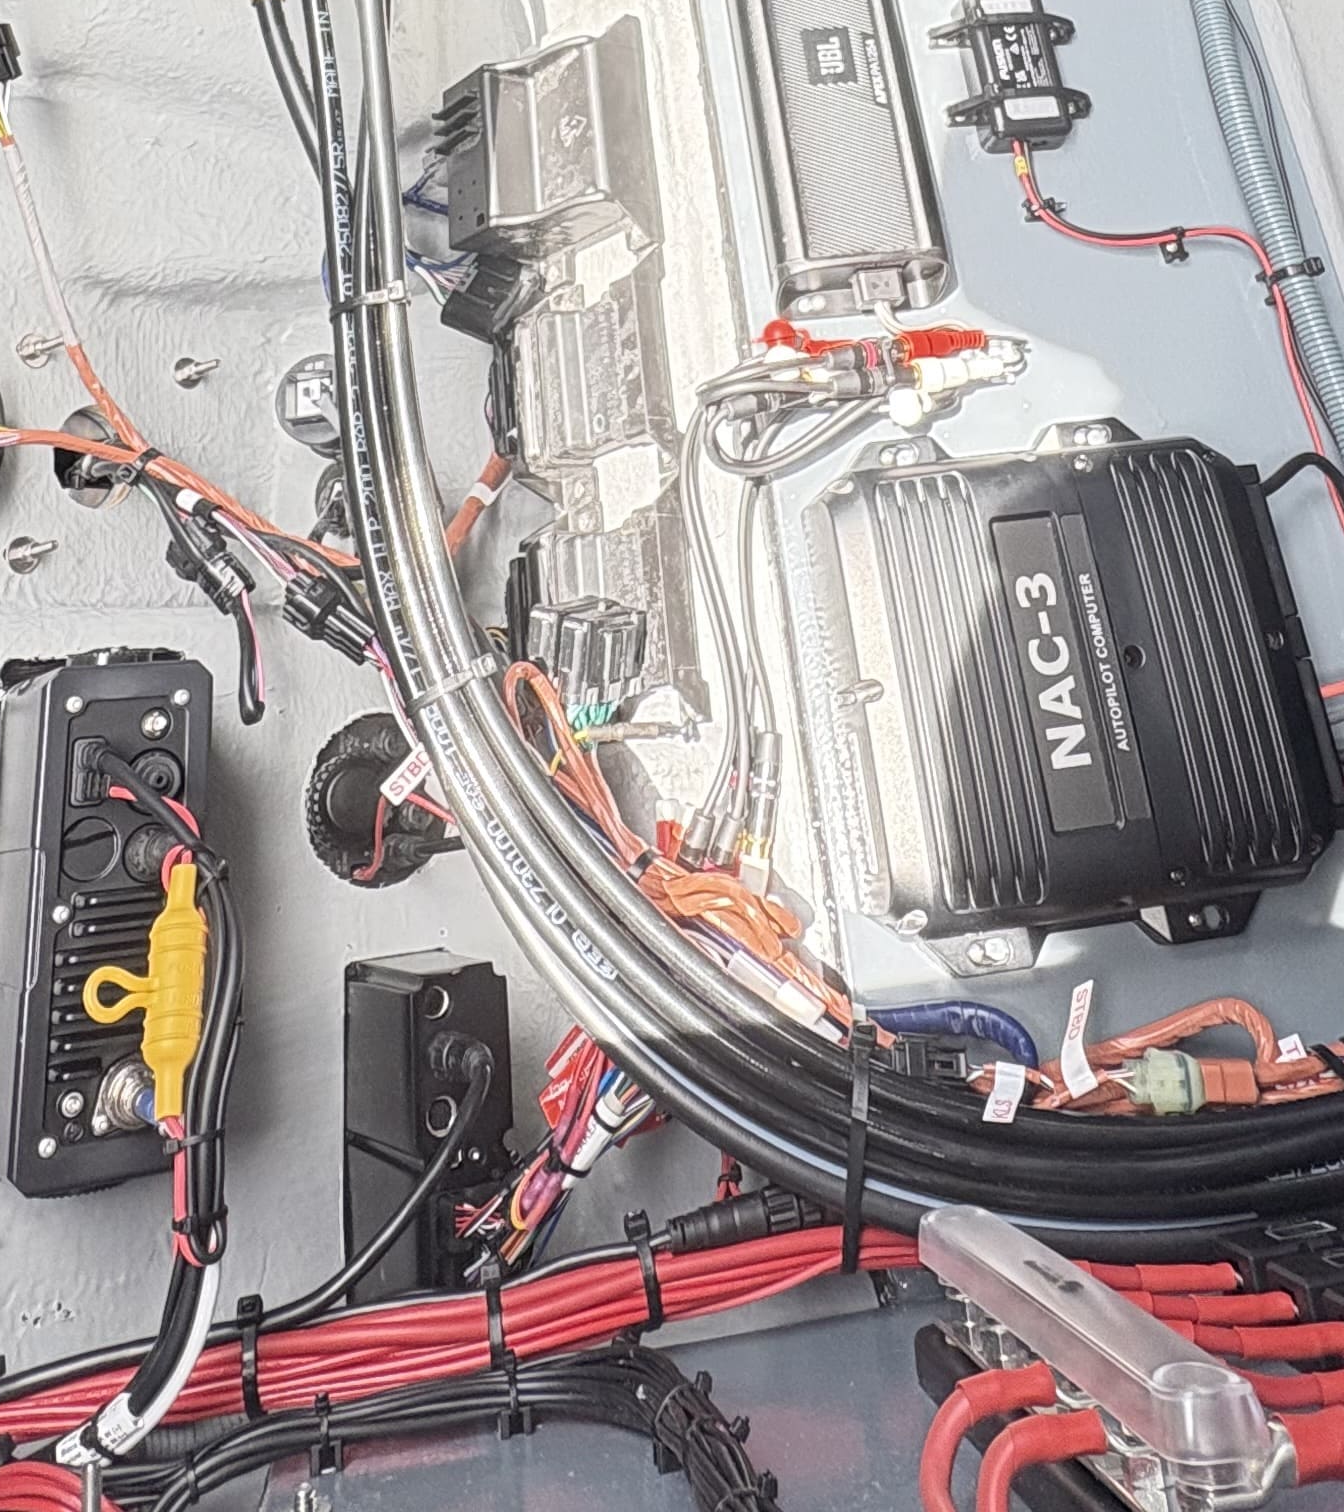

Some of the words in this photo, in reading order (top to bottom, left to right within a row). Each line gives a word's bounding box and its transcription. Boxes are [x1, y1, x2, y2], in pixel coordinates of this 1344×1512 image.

[323, 44, 339, 98] MADE
[817, 35, 846, 77] JBL
[1078, 573, 1109, 658] COMPUTER
[1015, 572, 1093, 770] NAC-3
[1099, 662, 1131, 752] AUTOPILOT
